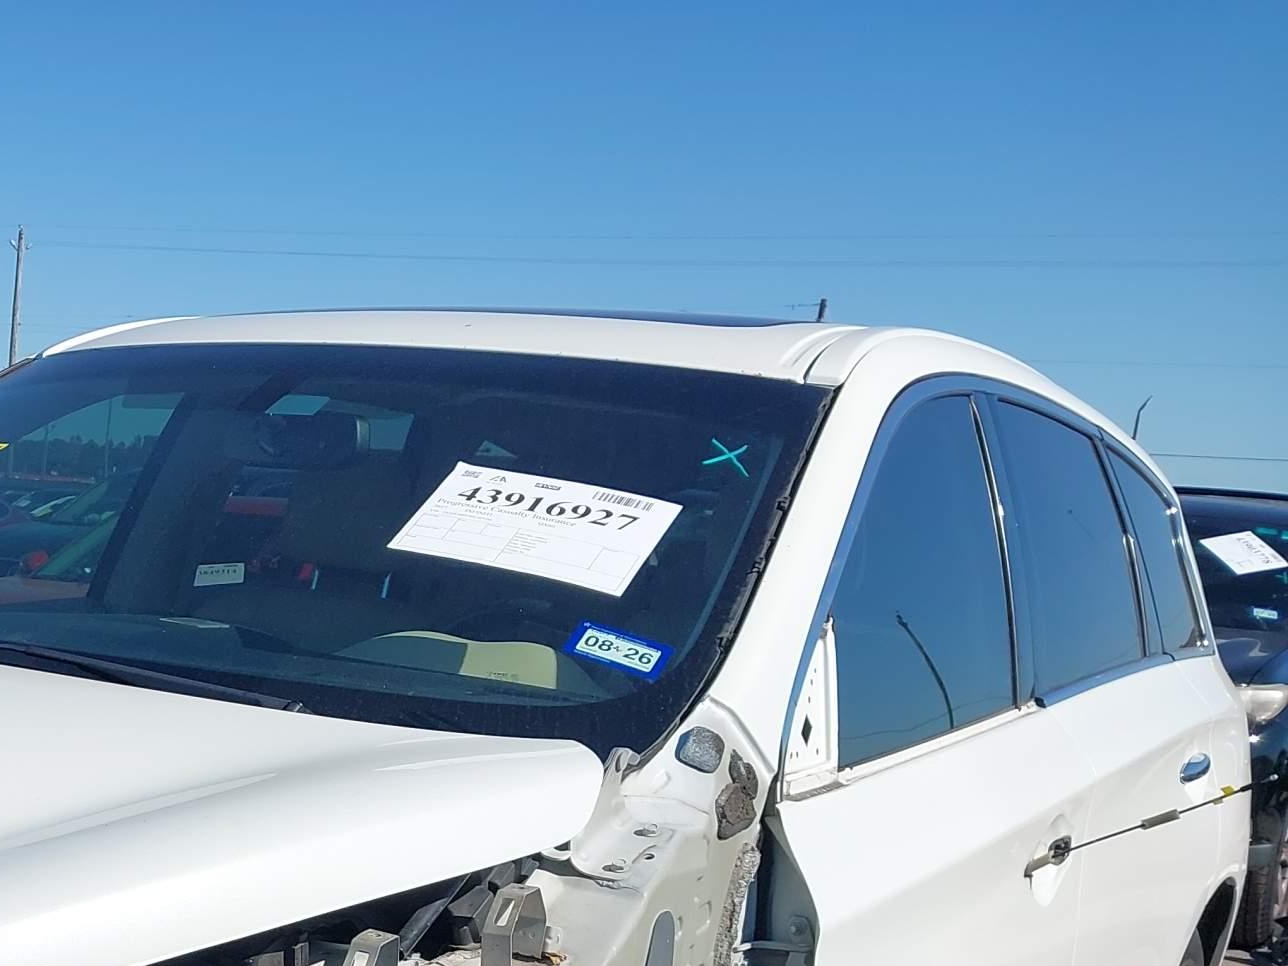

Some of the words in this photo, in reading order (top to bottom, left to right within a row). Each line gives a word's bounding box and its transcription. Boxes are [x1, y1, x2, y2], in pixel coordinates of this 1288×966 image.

[437, 497, 490, 511] Progressive
[490, 504, 530, 518] Casualty
[532, 511, 577, 527] Insurance
[457, 485, 640, 530] 43916927
[584, 635, 615, 652] 08
[622, 647, 654, 665] 26
